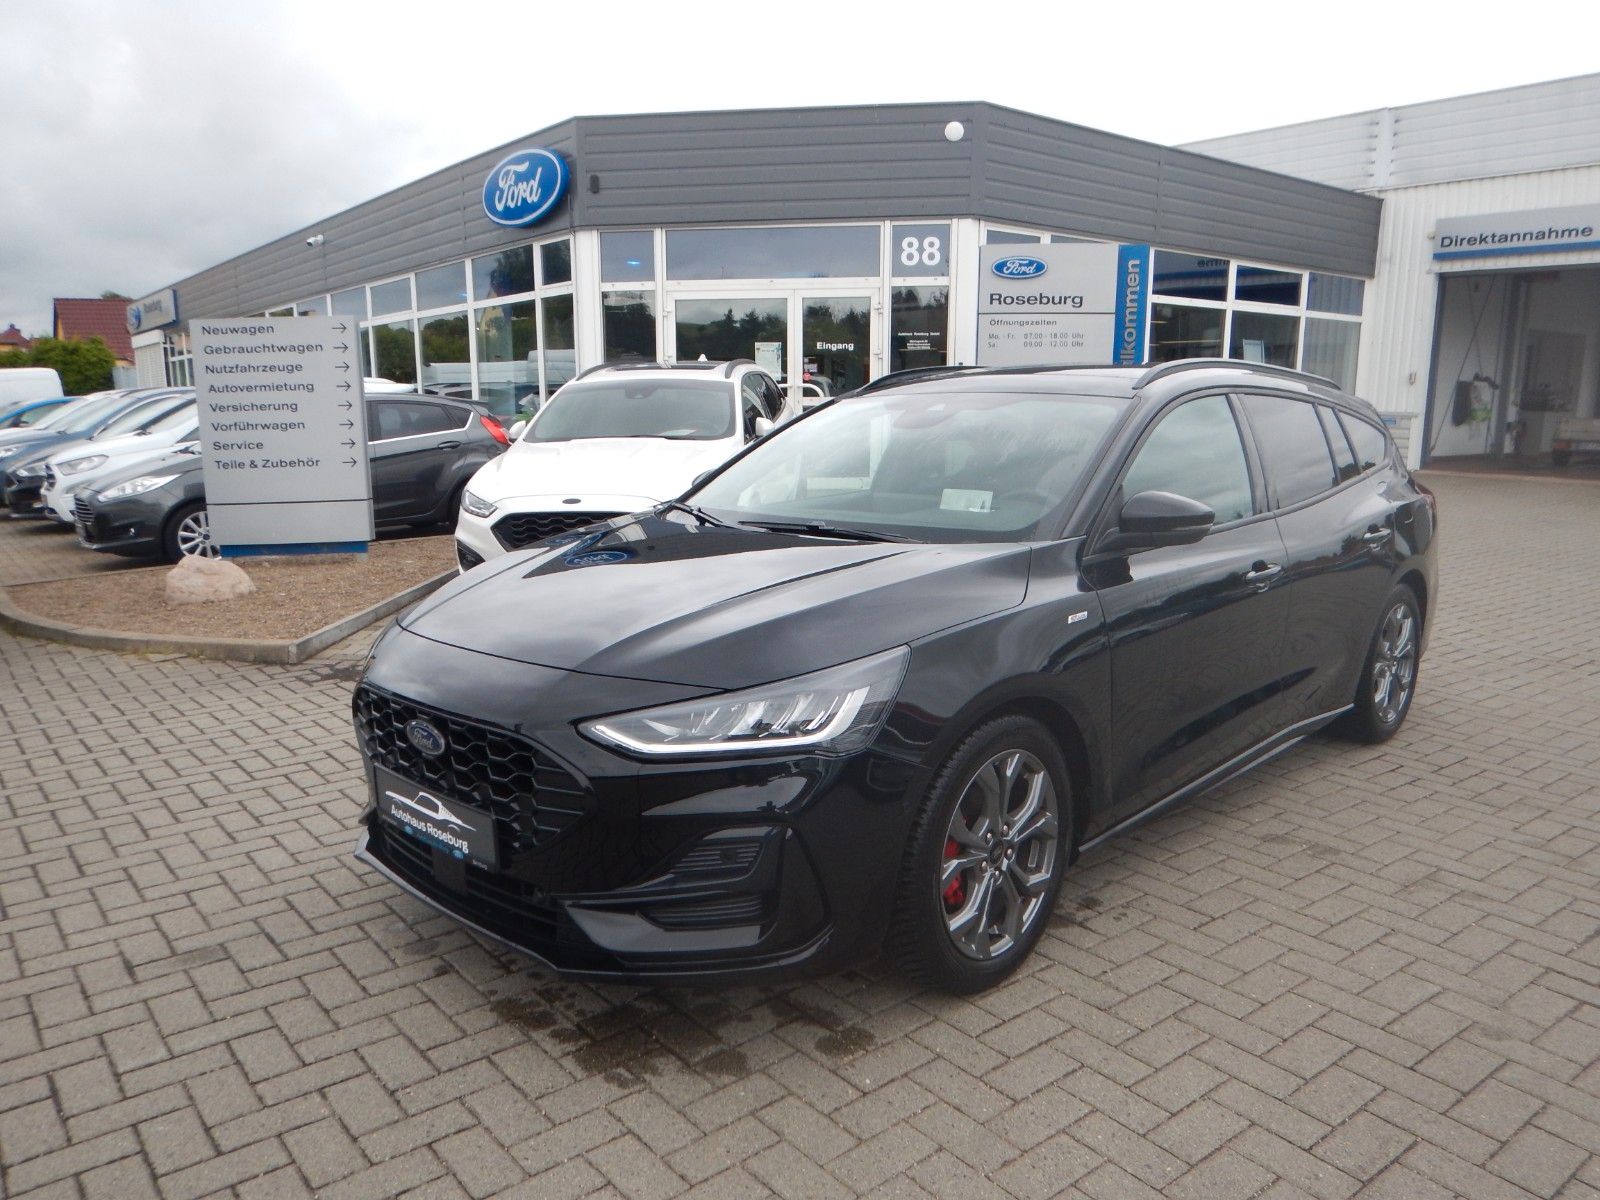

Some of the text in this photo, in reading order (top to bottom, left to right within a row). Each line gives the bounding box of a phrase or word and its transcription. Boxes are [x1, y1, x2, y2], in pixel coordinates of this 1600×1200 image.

[494, 160, 543, 212] Ford
[1440, 225, 1594, 249] Direktannahme
[900, 236, 941, 266] 88
[1002, 258, 1038, 275] Ford
[989, 292, 1084, 308] Roseburg
[201, 325, 275, 336] Neuwagen
[203, 343, 323, 355] Gebrauchtwagen
[816, 341, 854, 351] Eingang
[205, 363, 303, 375] Nutzfahrzeuge
[208, 382, 315, 394] Autovermietung
[209, 401, 298, 413] Versicherung
[211, 420, 306, 432] Vorführwagen
[213, 441, 264, 451] Service
[215, 457, 321, 470] Teile & Zubehör
[391, 804, 427, 832] Autohaus
[426, 822, 469, 854] Roseburg
